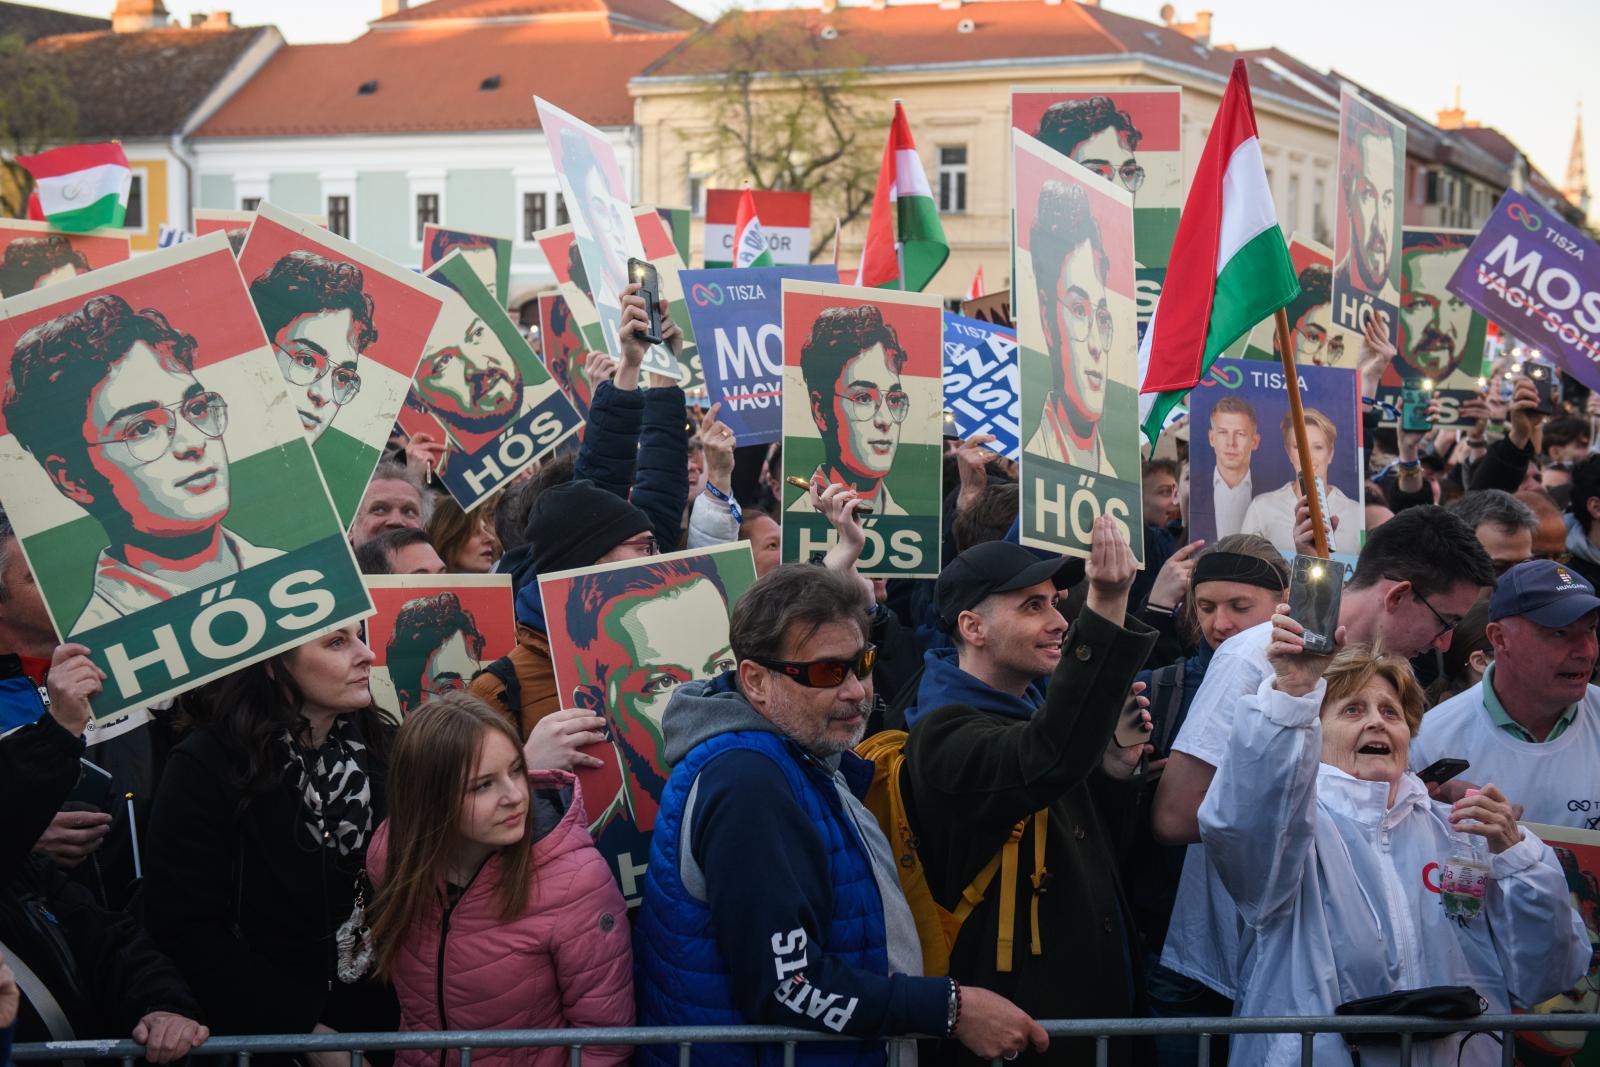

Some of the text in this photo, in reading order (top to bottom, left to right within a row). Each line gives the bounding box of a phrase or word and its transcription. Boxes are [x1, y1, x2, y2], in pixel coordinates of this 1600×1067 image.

[1545, 227, 1584, 261] TISZA
[726, 285, 766, 301] TISZA
[1477, 264, 1544, 318] VAGY
[1484, 234, 1600, 333] MOS
[951, 321, 991, 341] TISZ
[462, 411, 563, 496] HŐS
[1035, 474, 1131, 548] HŐS
[104, 569, 336, 700] HŐS
[771, 927, 859, 1032] PATRTS
